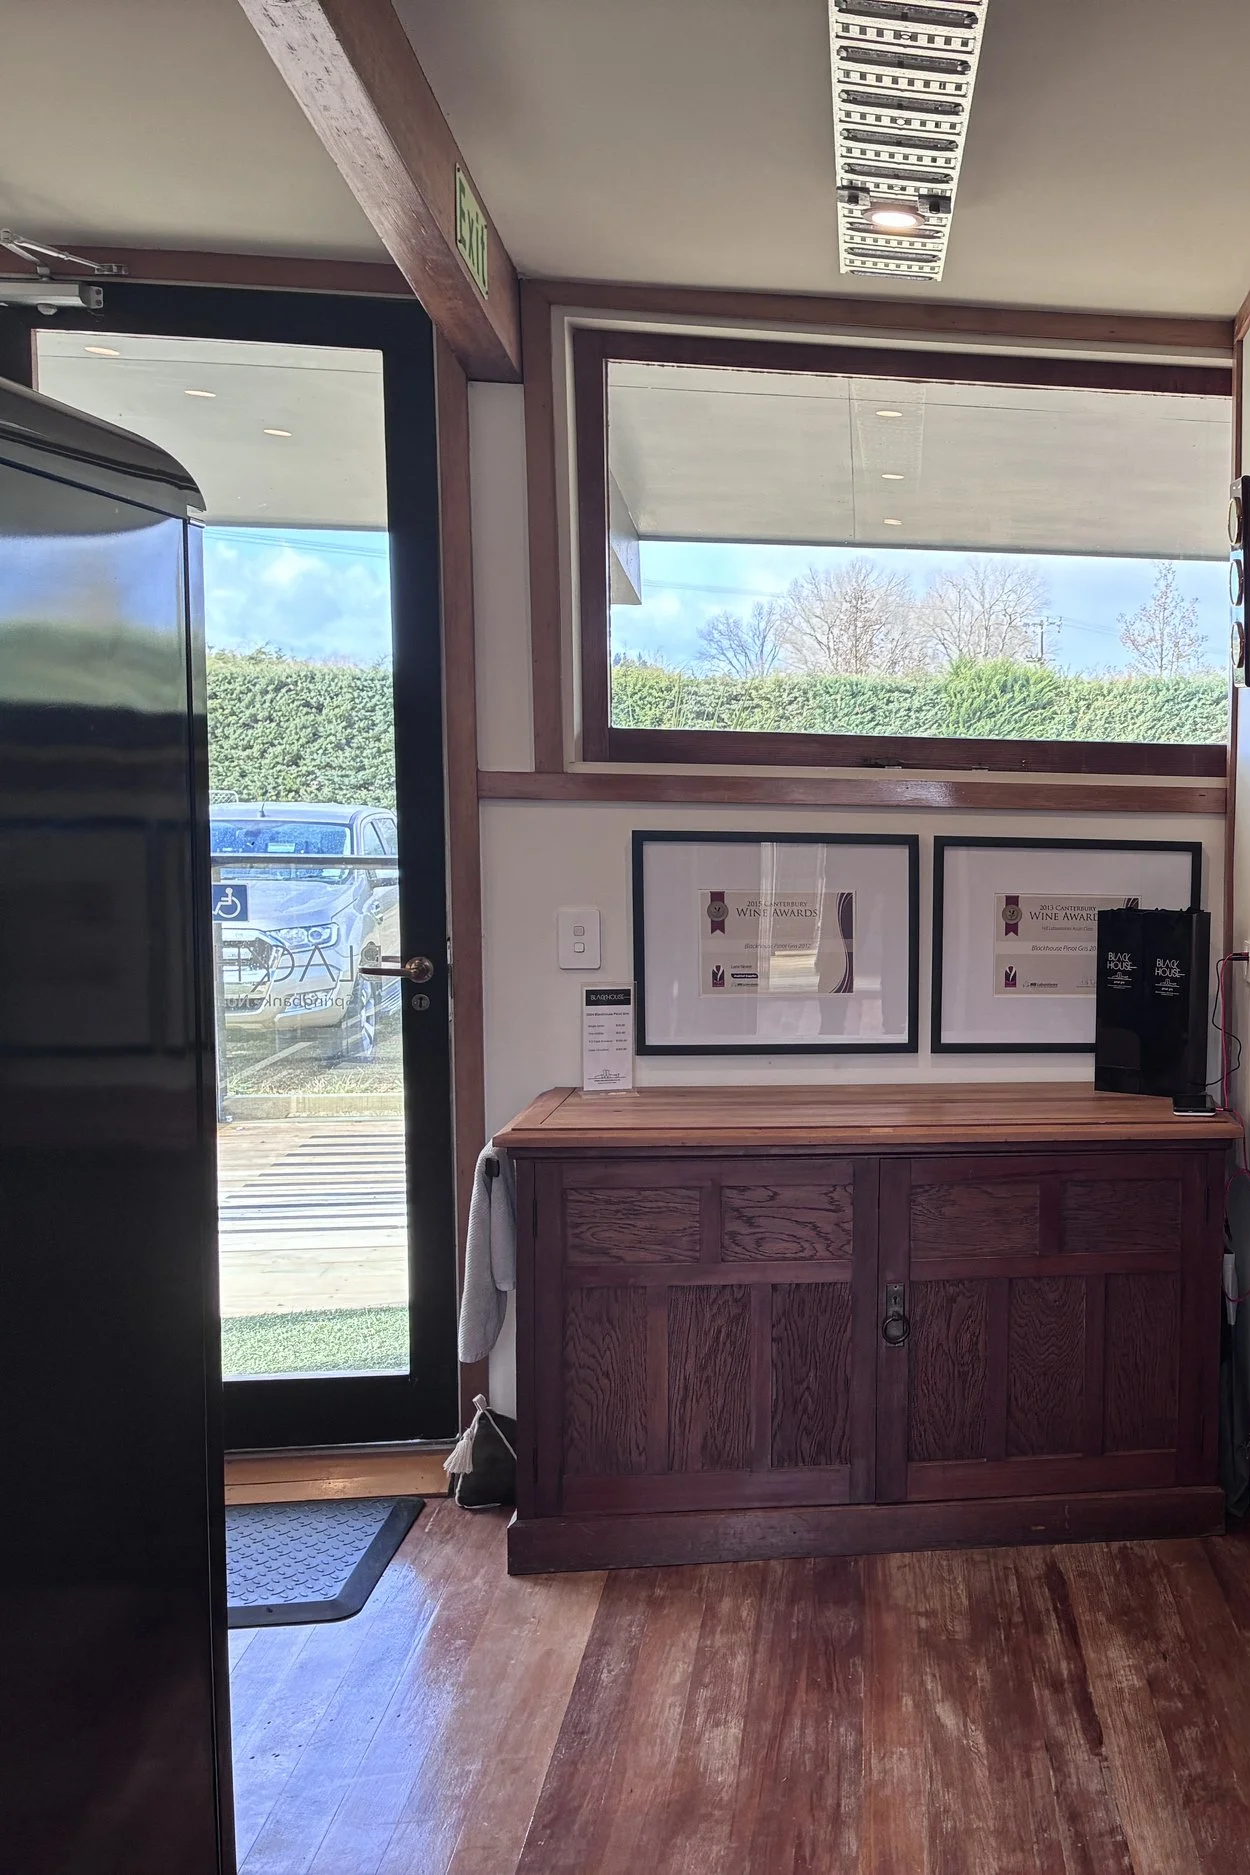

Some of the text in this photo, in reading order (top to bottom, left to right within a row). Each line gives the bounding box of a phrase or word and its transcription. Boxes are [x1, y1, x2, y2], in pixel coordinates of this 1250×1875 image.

[458, 177, 486, 287] Exit
[736, 907, 818, 918] WINE AWARDS
[1029, 911, 1098, 921] WINE AWAR
[1108, 952, 1131, 962] BLACK
[1106, 961, 1137, 971] HOUSE
[1156, 959, 1180, 969] BLACK
[1155, 967, 1186, 978] HOUSE
